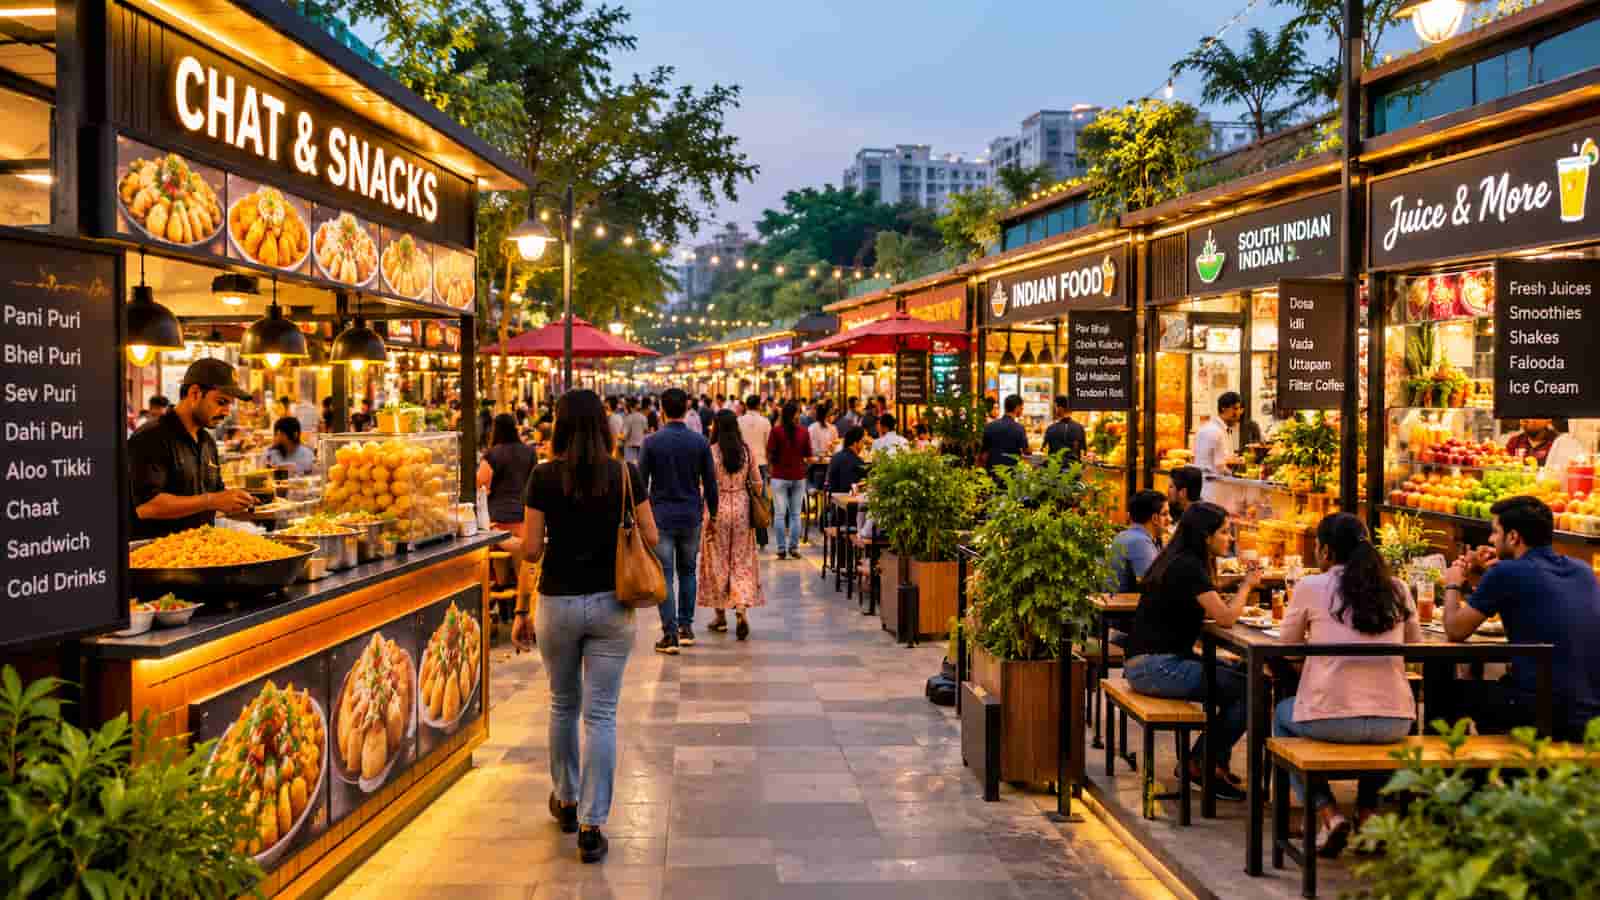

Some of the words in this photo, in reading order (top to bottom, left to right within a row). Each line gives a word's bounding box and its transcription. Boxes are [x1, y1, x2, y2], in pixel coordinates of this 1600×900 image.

[175, 55, 286, 161] CHAT
[294, 112, 318, 176] &
[327, 126, 438, 223] SNACKS
[1383, 194, 1447, 250] Juice
[1451, 184, 1471, 225] &
[1479, 172, 1552, 222] More
[1238, 224, 1280, 250] SOUTH
[1283, 213, 1331, 242] INDIAN
[1239, 244, 1285, 271] INDIAN
[1012, 275, 1057, 308] INDIAN
[1060, 265, 1101, 300] FOOD
[1509, 280, 1545, 296] Fresh
[1549, 280, 1592, 296] Juices
[1289, 297, 1314, 310] Dosa
[1509, 305, 1582, 320] Smoothies
[4, 305, 43, 326] Pani
[47, 309, 81, 329] Puri
[1509, 329, 1560, 345] Shakes
[4, 344, 44, 364] Bhel
[48, 347, 81, 366] Puri
[1289, 357, 1332, 373] Uttapam
[1509, 355, 1565, 370] Falooda
[4, 383, 38, 402] Sev
[43, 383, 77, 403] Puri
[1509, 380, 1531, 395] Ice
[1534, 380, 1580, 395] Cream
[5, 421, 46, 441] Dahi
[50, 421, 83, 440] Puri
[6, 461, 48, 480] Aloo
[51, 457, 92, 477] Tikki
[6, 498, 61, 520] Chaat
[7, 531, 91, 559] Sandwich
[7, 574, 49, 598] Cold
[53, 567, 107, 591] Drinks
